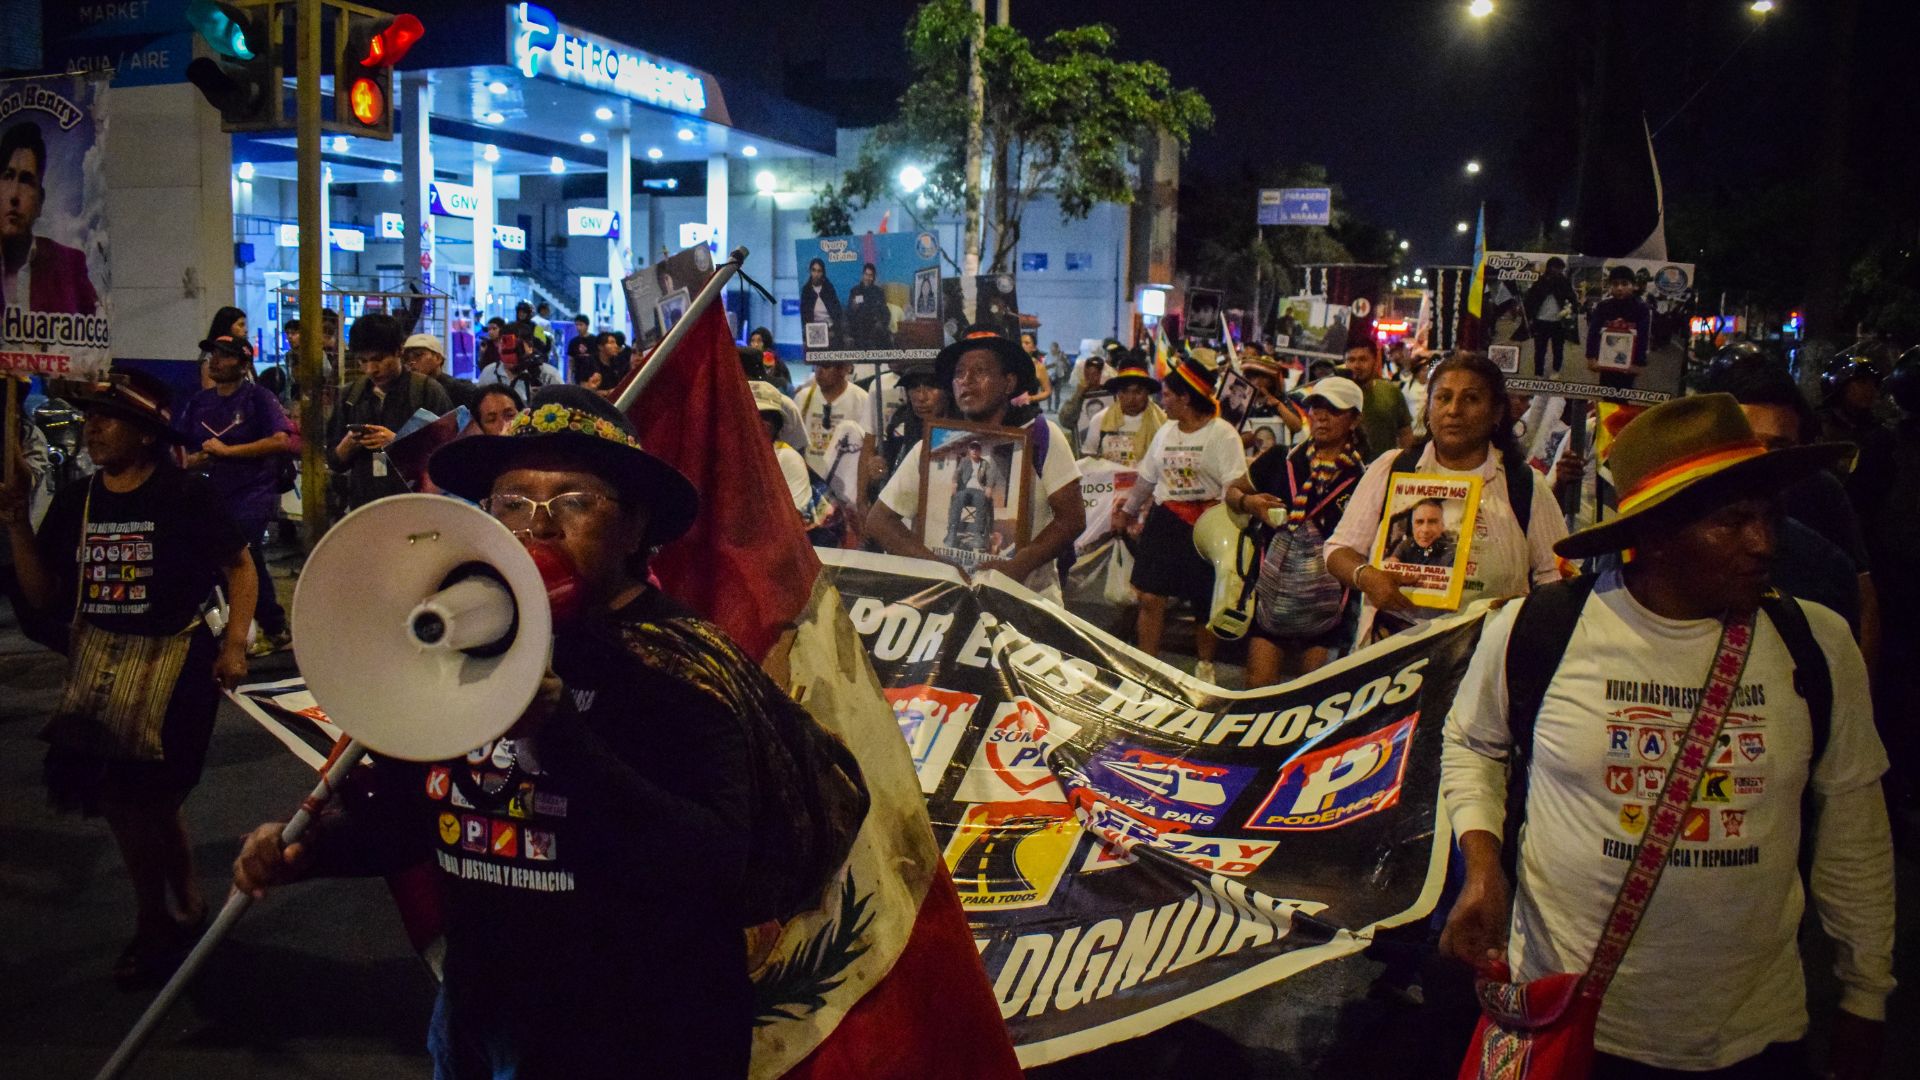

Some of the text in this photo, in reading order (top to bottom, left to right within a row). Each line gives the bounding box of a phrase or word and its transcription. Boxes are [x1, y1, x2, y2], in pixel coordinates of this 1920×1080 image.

[80, 2, 148, 20] MARKET
[67, 56, 110, 73] AGUA
[130, 51, 170, 69] AIRE
[431, 191, 438, 204] 7
[451, 194, 478, 210] GNV
[580, 216, 602, 228] GNV
[612, 219, 619, 230] 6
[5, 307, 109, 342] Huarancca
[866, 350, 903, 360] EXIGIMOS
[1564, 383, 1617, 397] EXIGIMOS
[1395, 485, 1467, 498] NI UN MUERTO MAS
[1384, 562, 1446, 575] JUSTICIA PARA
[849, 598, 954, 663] POR
[1099, 658, 1429, 747] MAFIOSOS
[1606, 680, 1639, 702] NUNCA
[1641, 680, 1661, 705] MÁS
[1663, 686, 1680, 707] POR
[1612, 731, 1661, 755] R A
[428, 772, 447, 796] K
[1610, 772, 1729, 797] K K
[1266, 790, 1386, 825] PODEMOS
[1161, 811, 1216, 826] PAÍS
[467, 820, 482, 842] P
[1238, 845, 1271, 859] Y
[1694, 852, 1700, 867] Y
[1701, 846, 1759, 867] REPARACIÓN
[461, 858, 501, 886] JUSTICIA
[503, 867, 510, 886] Y
[511, 866, 575, 892] REPARACIÓN
[962, 896, 993, 904] PARA
[998, 893, 1038, 904] TODOS
